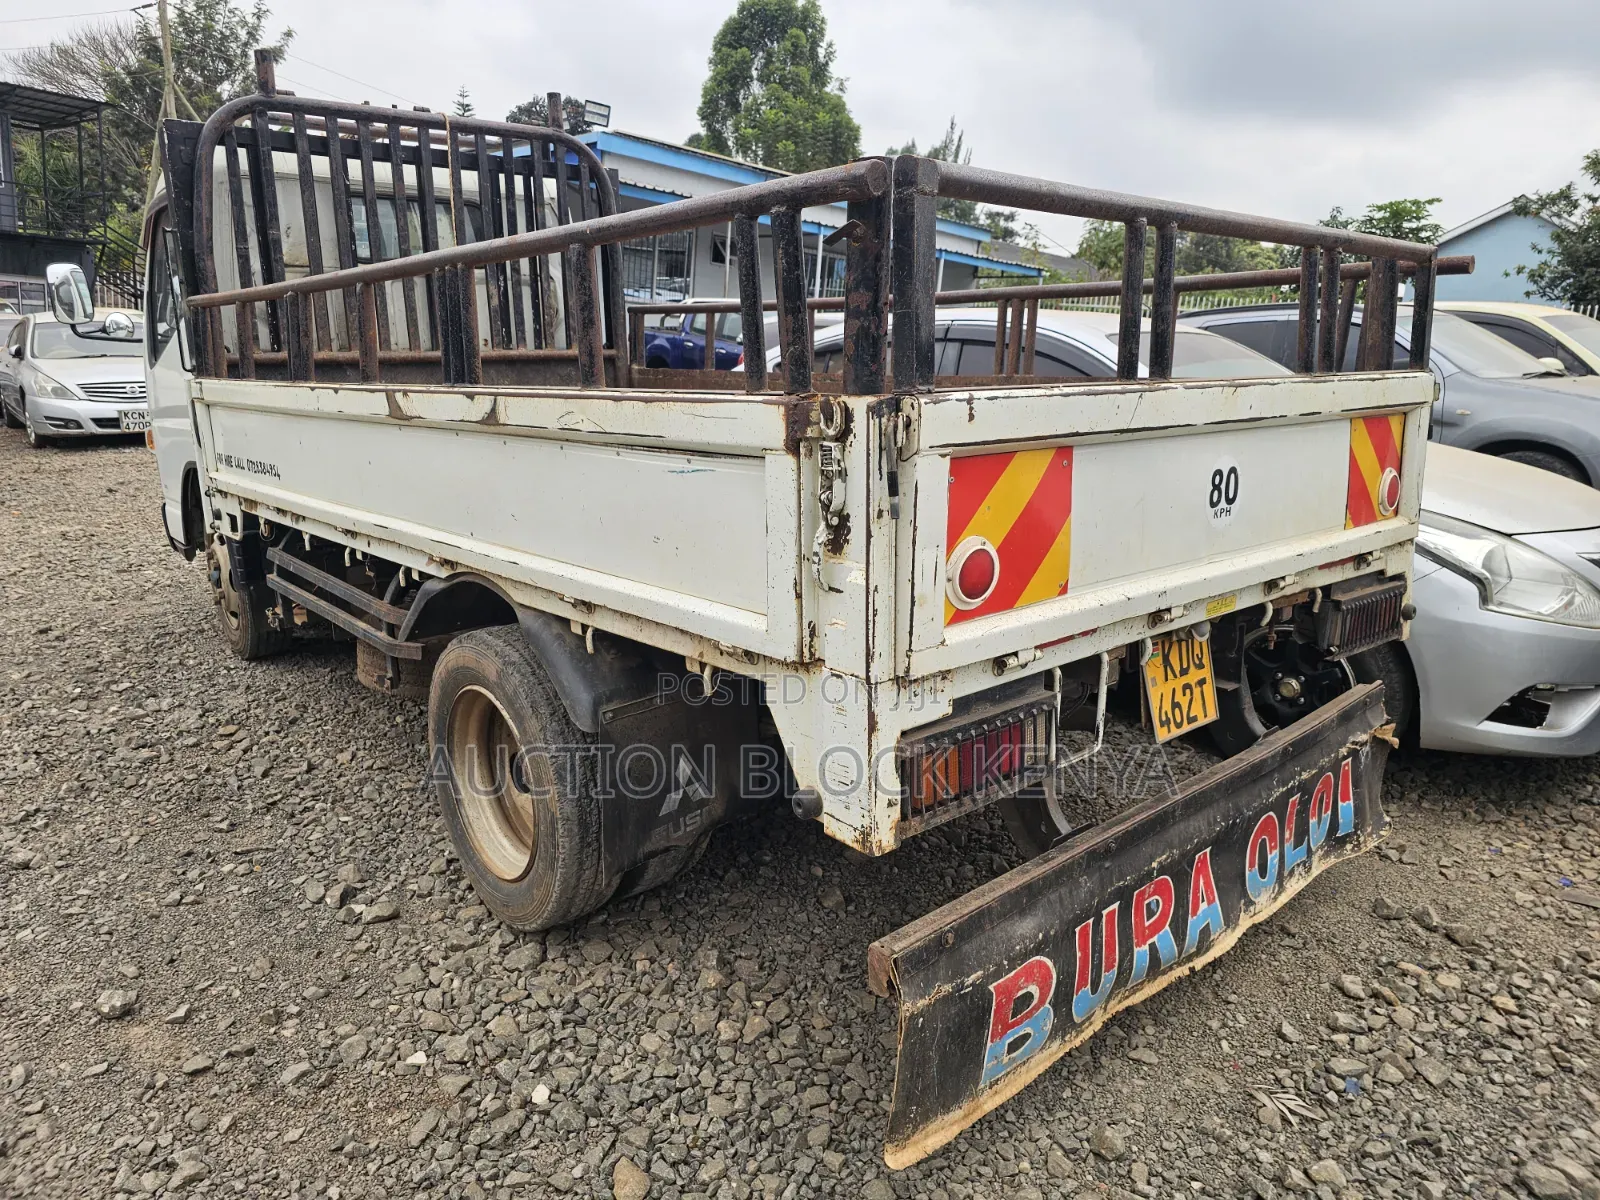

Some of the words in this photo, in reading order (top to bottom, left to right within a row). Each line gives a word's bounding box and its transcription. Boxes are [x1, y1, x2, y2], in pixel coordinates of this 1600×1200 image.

[124, 411, 146, 420] KCN
[224, 453, 234, 468] HIRE
[1209, 466, 1239, 508] 80
[1213, 506, 1232, 519] KPH
[1160, 638, 1206, 682] KDQ
[1158, 676, 1207, 734] 462T
[980, 846, 1225, 1086] BURA
[1245, 757, 1355, 902] OLOI
